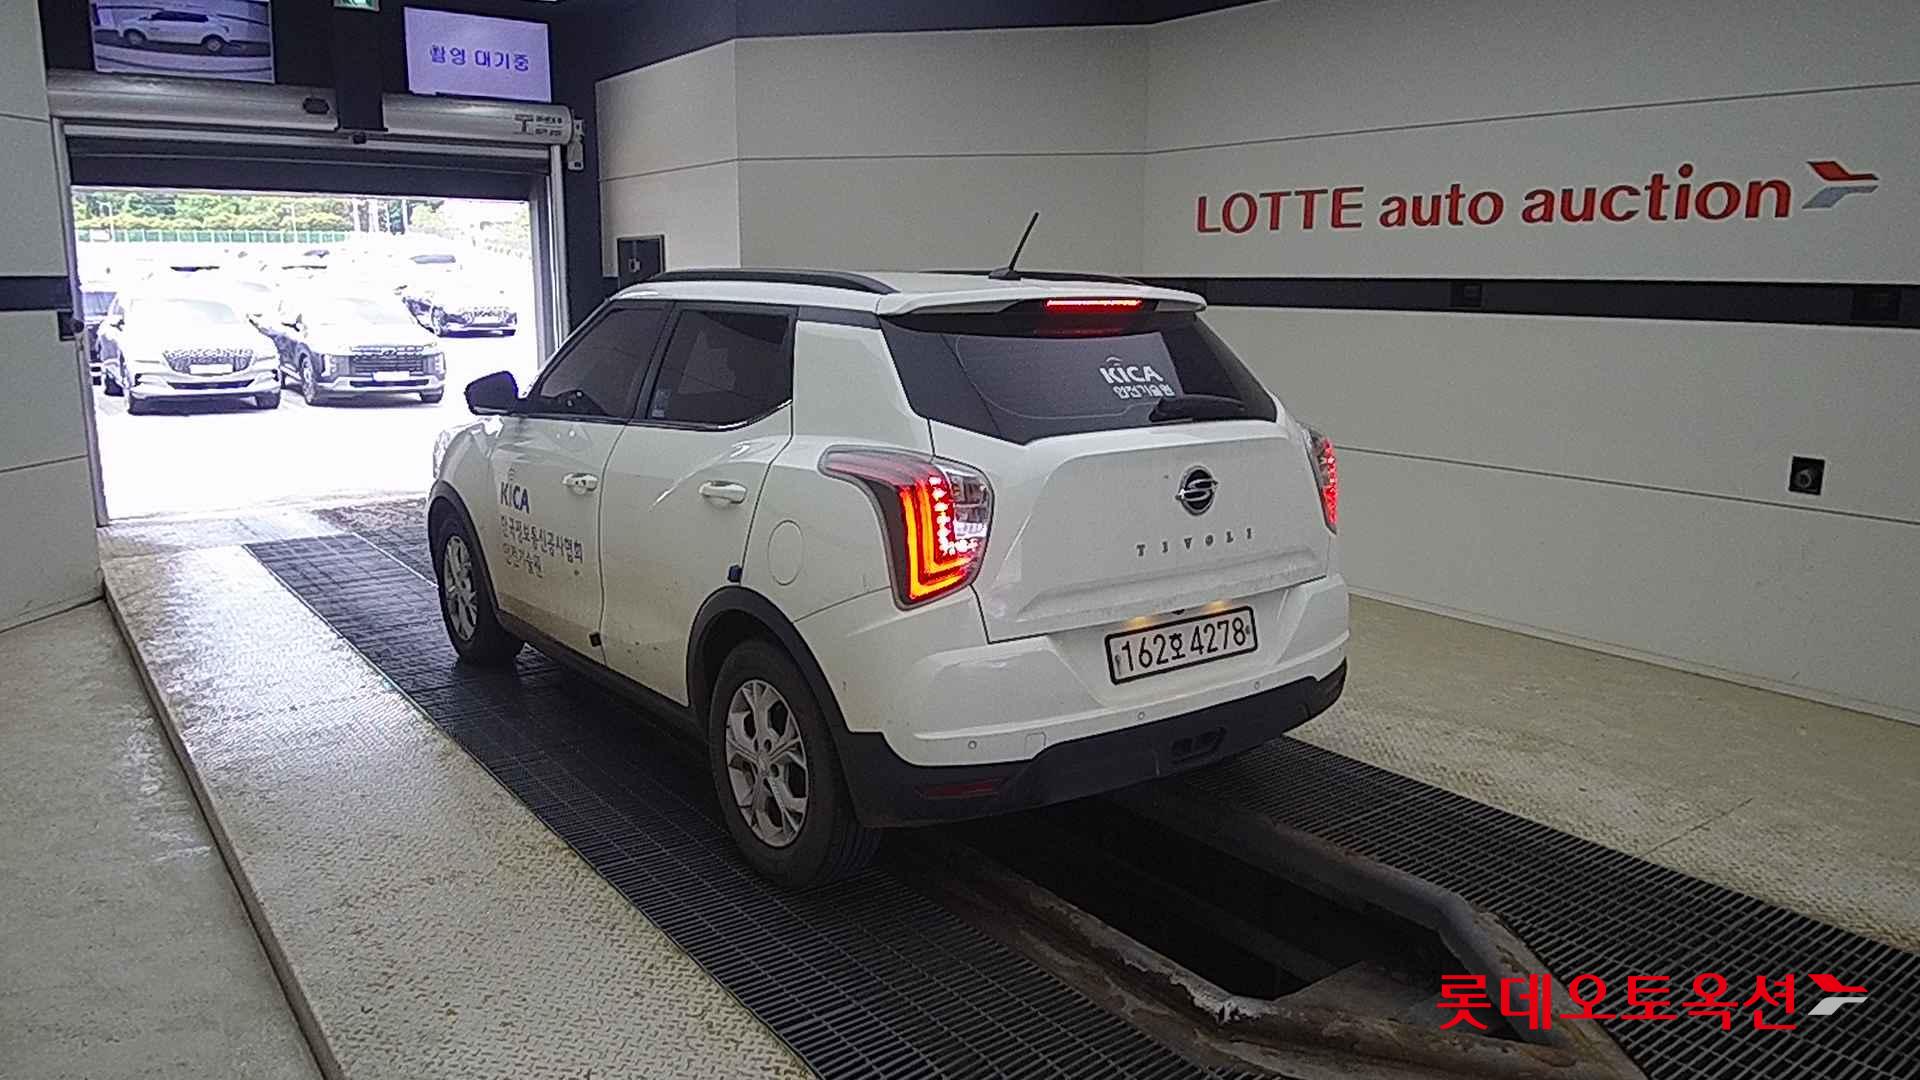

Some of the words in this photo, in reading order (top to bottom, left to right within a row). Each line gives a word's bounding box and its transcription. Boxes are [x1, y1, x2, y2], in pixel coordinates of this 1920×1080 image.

[475, 50, 529, 72] 대기중
[1197, 187, 1364, 234] LOTTE
[1379, 183, 1504, 228] auto
[1522, 163, 1791, 223] auction
[1100, 366, 1163, 383] KICA
[500, 481, 530, 514] KICA
[1136, 527, 1253, 557] TIVOLI
